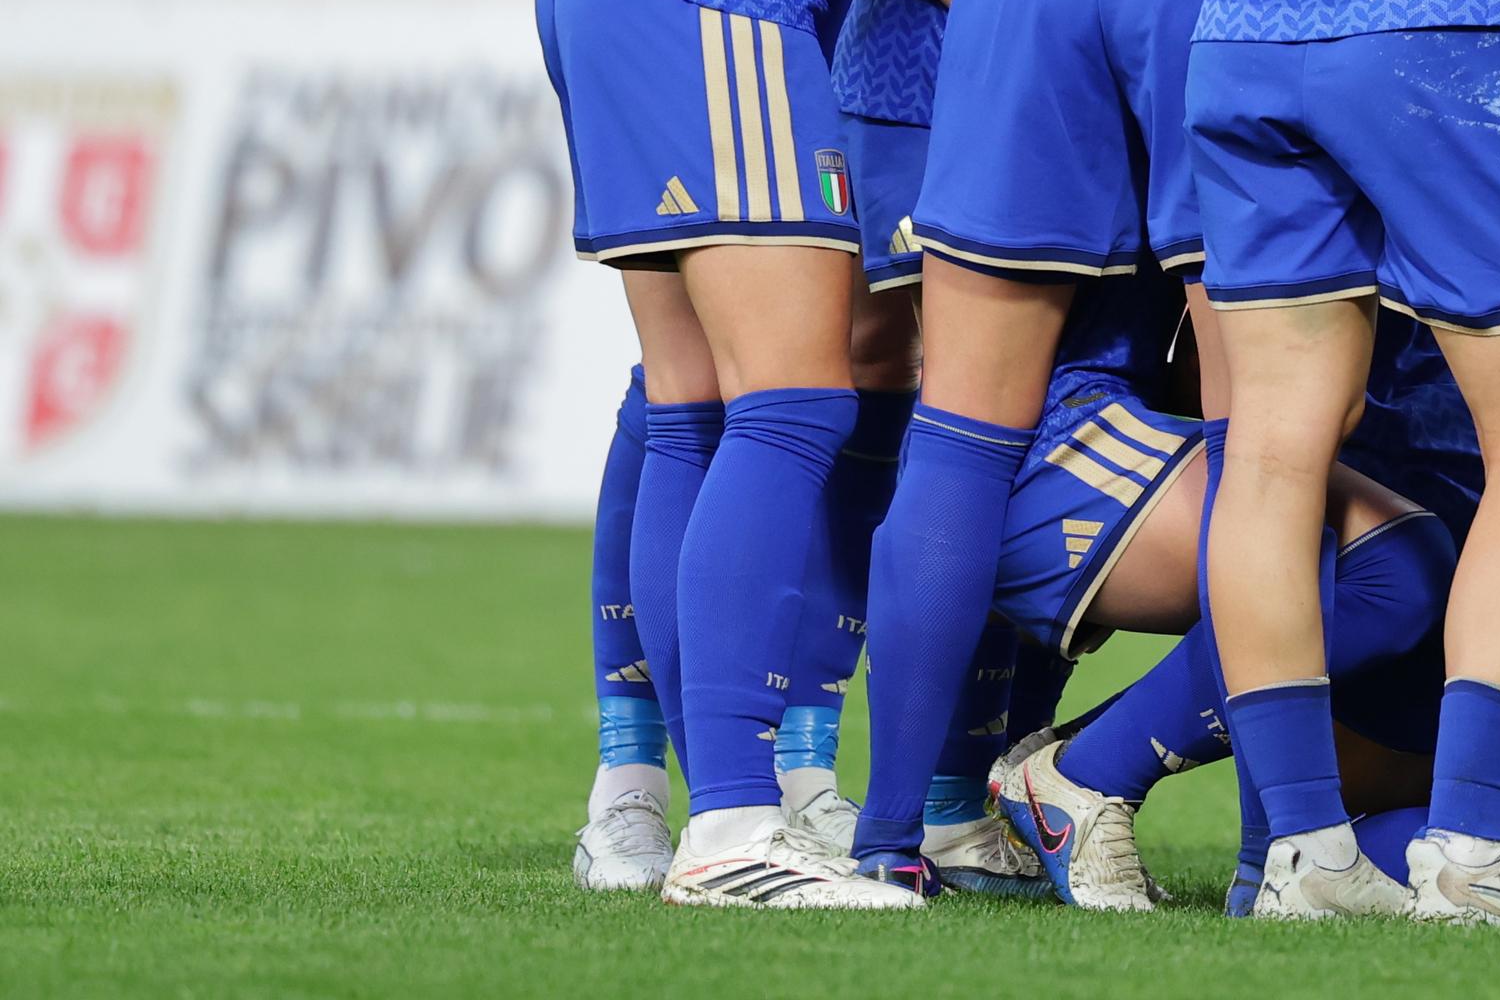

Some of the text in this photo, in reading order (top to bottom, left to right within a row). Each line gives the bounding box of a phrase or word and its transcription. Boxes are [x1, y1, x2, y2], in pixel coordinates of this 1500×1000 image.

[208, 135, 568, 300] PIVO
[600, 604, 635, 620] ITA
[837, 614, 867, 634] ITA
[766, 671, 791, 691] ITA
